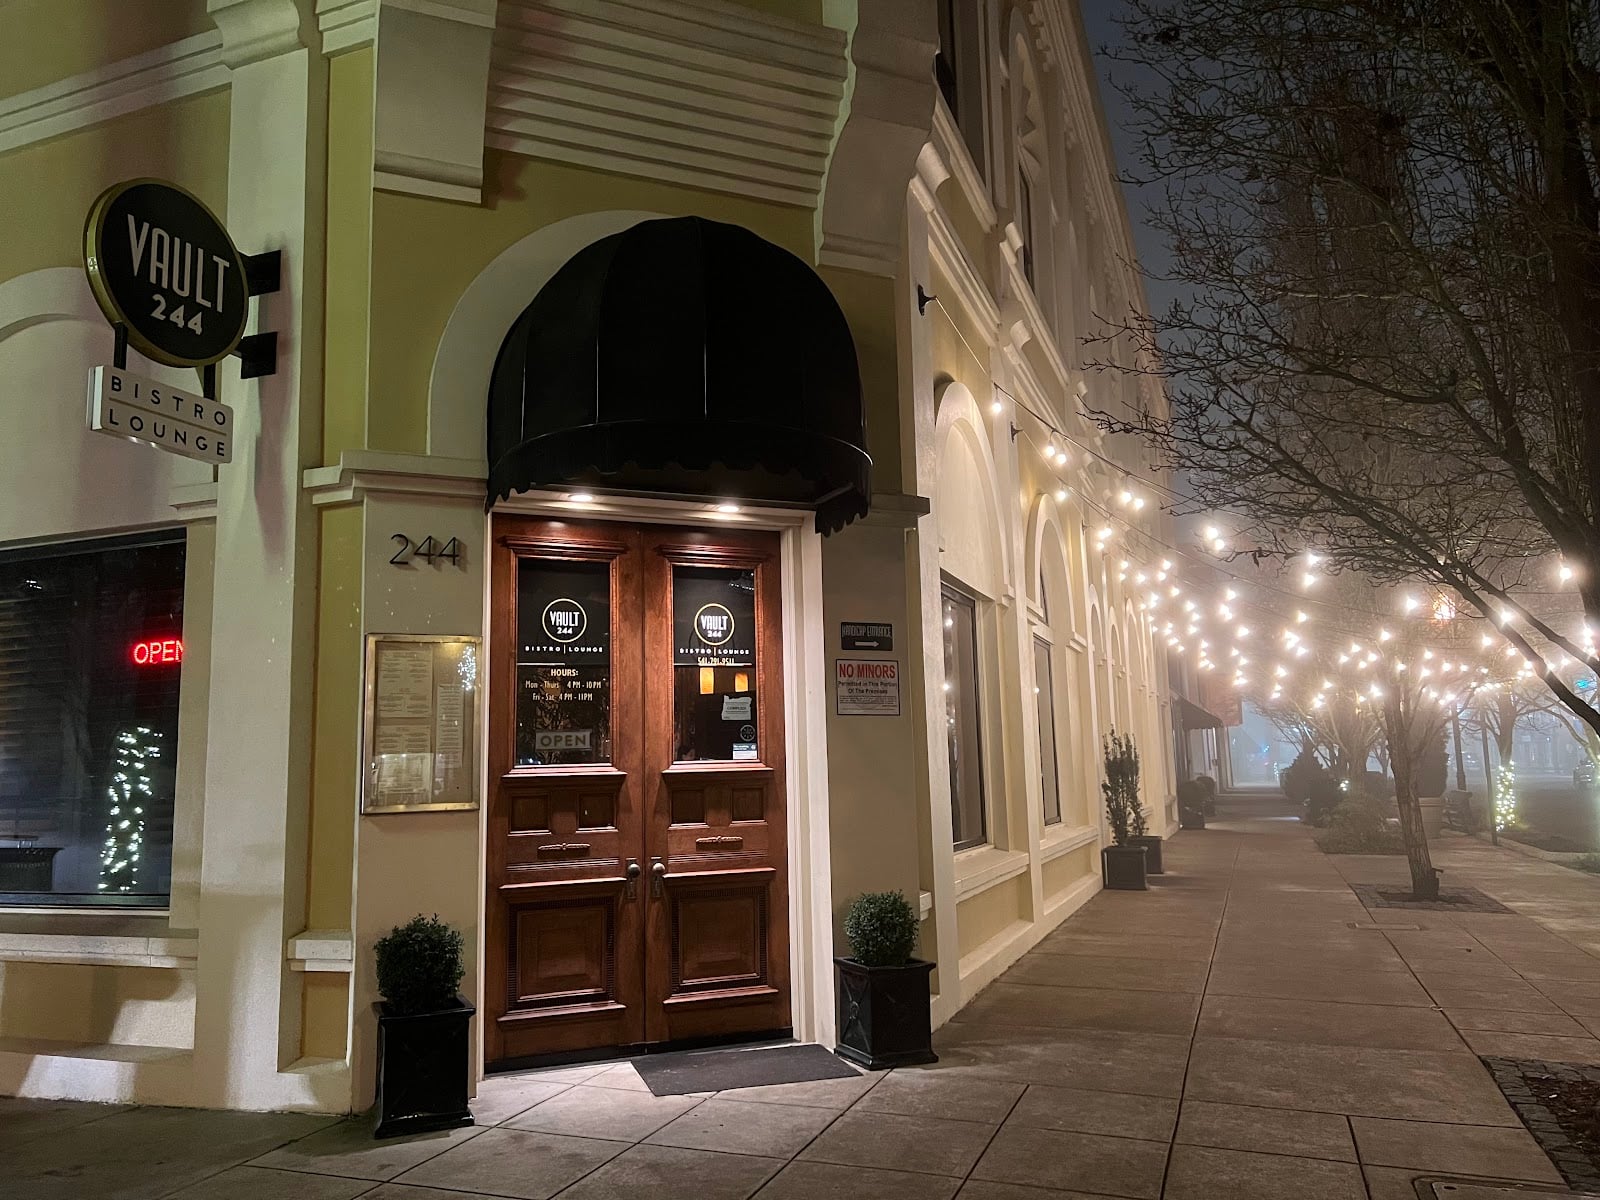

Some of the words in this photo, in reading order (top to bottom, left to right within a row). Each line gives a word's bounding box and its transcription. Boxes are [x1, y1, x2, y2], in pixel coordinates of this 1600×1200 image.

[127, 213, 230, 313] VAULT
[151, 293, 204, 336] 244
[111, 375, 226, 426] BISTRO
[109, 408, 225, 457] LOUNGE
[389, 533, 460, 567] 244
[549, 610, 580, 627] VAULT
[700, 615, 729, 630] VAULT
[557, 627, 573, 635] 244
[707, 630, 722, 638] 244
[550, 668, 579, 677] HOURS:
[839, 663, 854, 678] NO
[857, 663, 896, 679] MINORS
[525, 680, 538, 689] Mon
[544, 680, 560, 689] Thurs
[540, 734, 587, 747] OPEN
